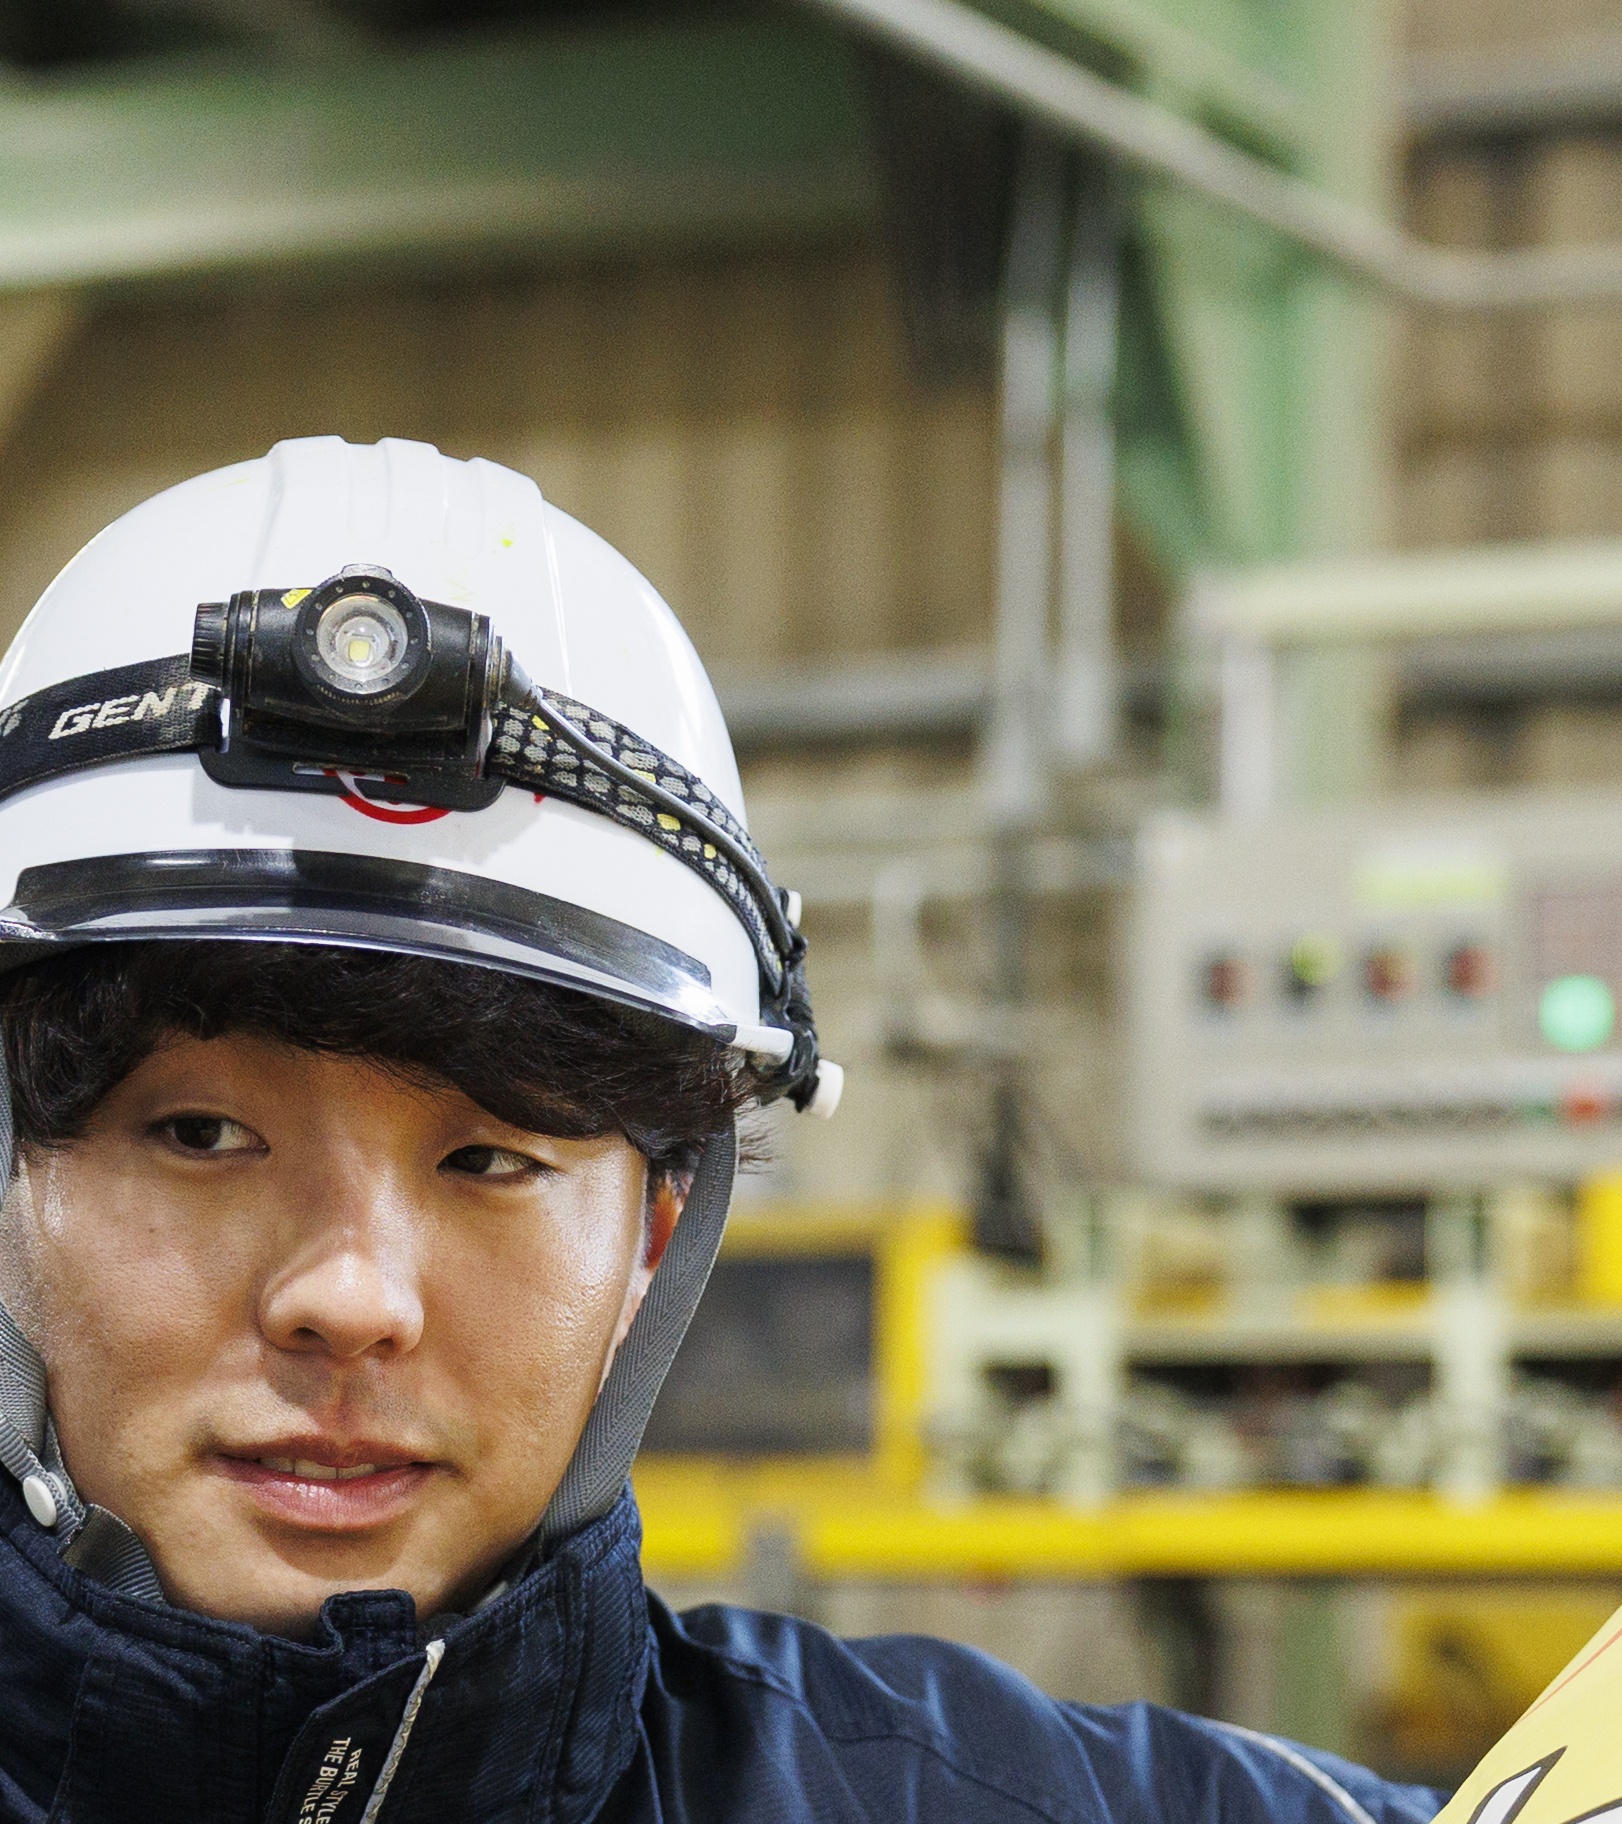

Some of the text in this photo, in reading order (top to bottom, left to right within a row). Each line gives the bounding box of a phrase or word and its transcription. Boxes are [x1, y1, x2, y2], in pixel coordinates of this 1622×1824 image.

[323, 1736, 352, 1764] THE
[336, 1748, 363, 1788] REAL
[299, 1766, 339, 1815] BURTLE
